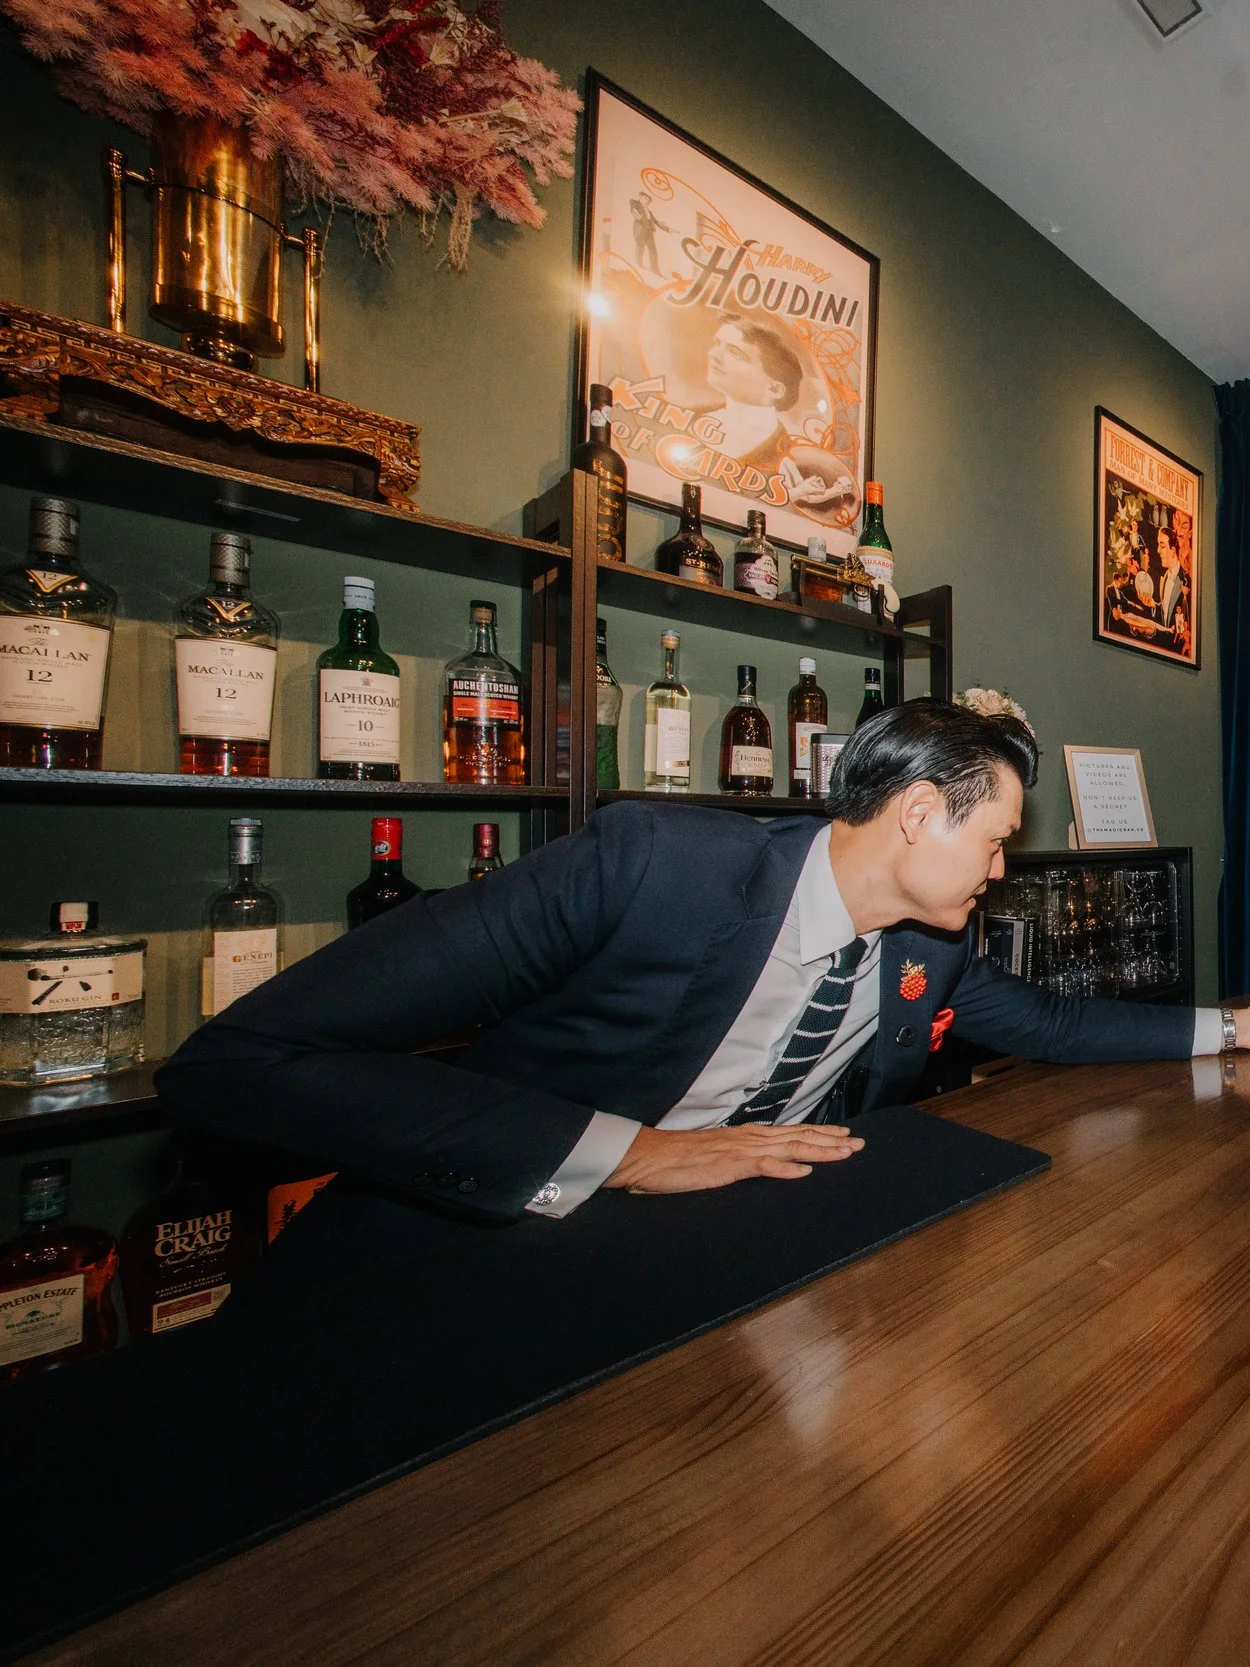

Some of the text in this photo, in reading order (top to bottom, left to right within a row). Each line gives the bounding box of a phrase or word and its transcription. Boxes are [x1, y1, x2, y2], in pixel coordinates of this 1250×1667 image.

[750, 243, 833, 284] HARRY
[667, 237, 859, 327] HOUDINI
[609, 375, 726, 446] KING
[655, 433, 790, 507] CARDS
[1157, 463, 1189, 501] COMPANY
[41, 572, 57, 581] 12
[26, 669, 53, 683] 12
[188, 664, 264, 680] MACALLAN
[216, 687, 237, 700] 12
[453, 680, 519, 695] AUCHENTOSHAN
[358, 720, 374, 732] 10
[49, 997, 79, 1005] ROKU
[155, 1210, 232, 1241] ELIJAH
[154, 1225, 232, 1258] CRAIG
[44, 1287, 80, 1298] ESTATE
